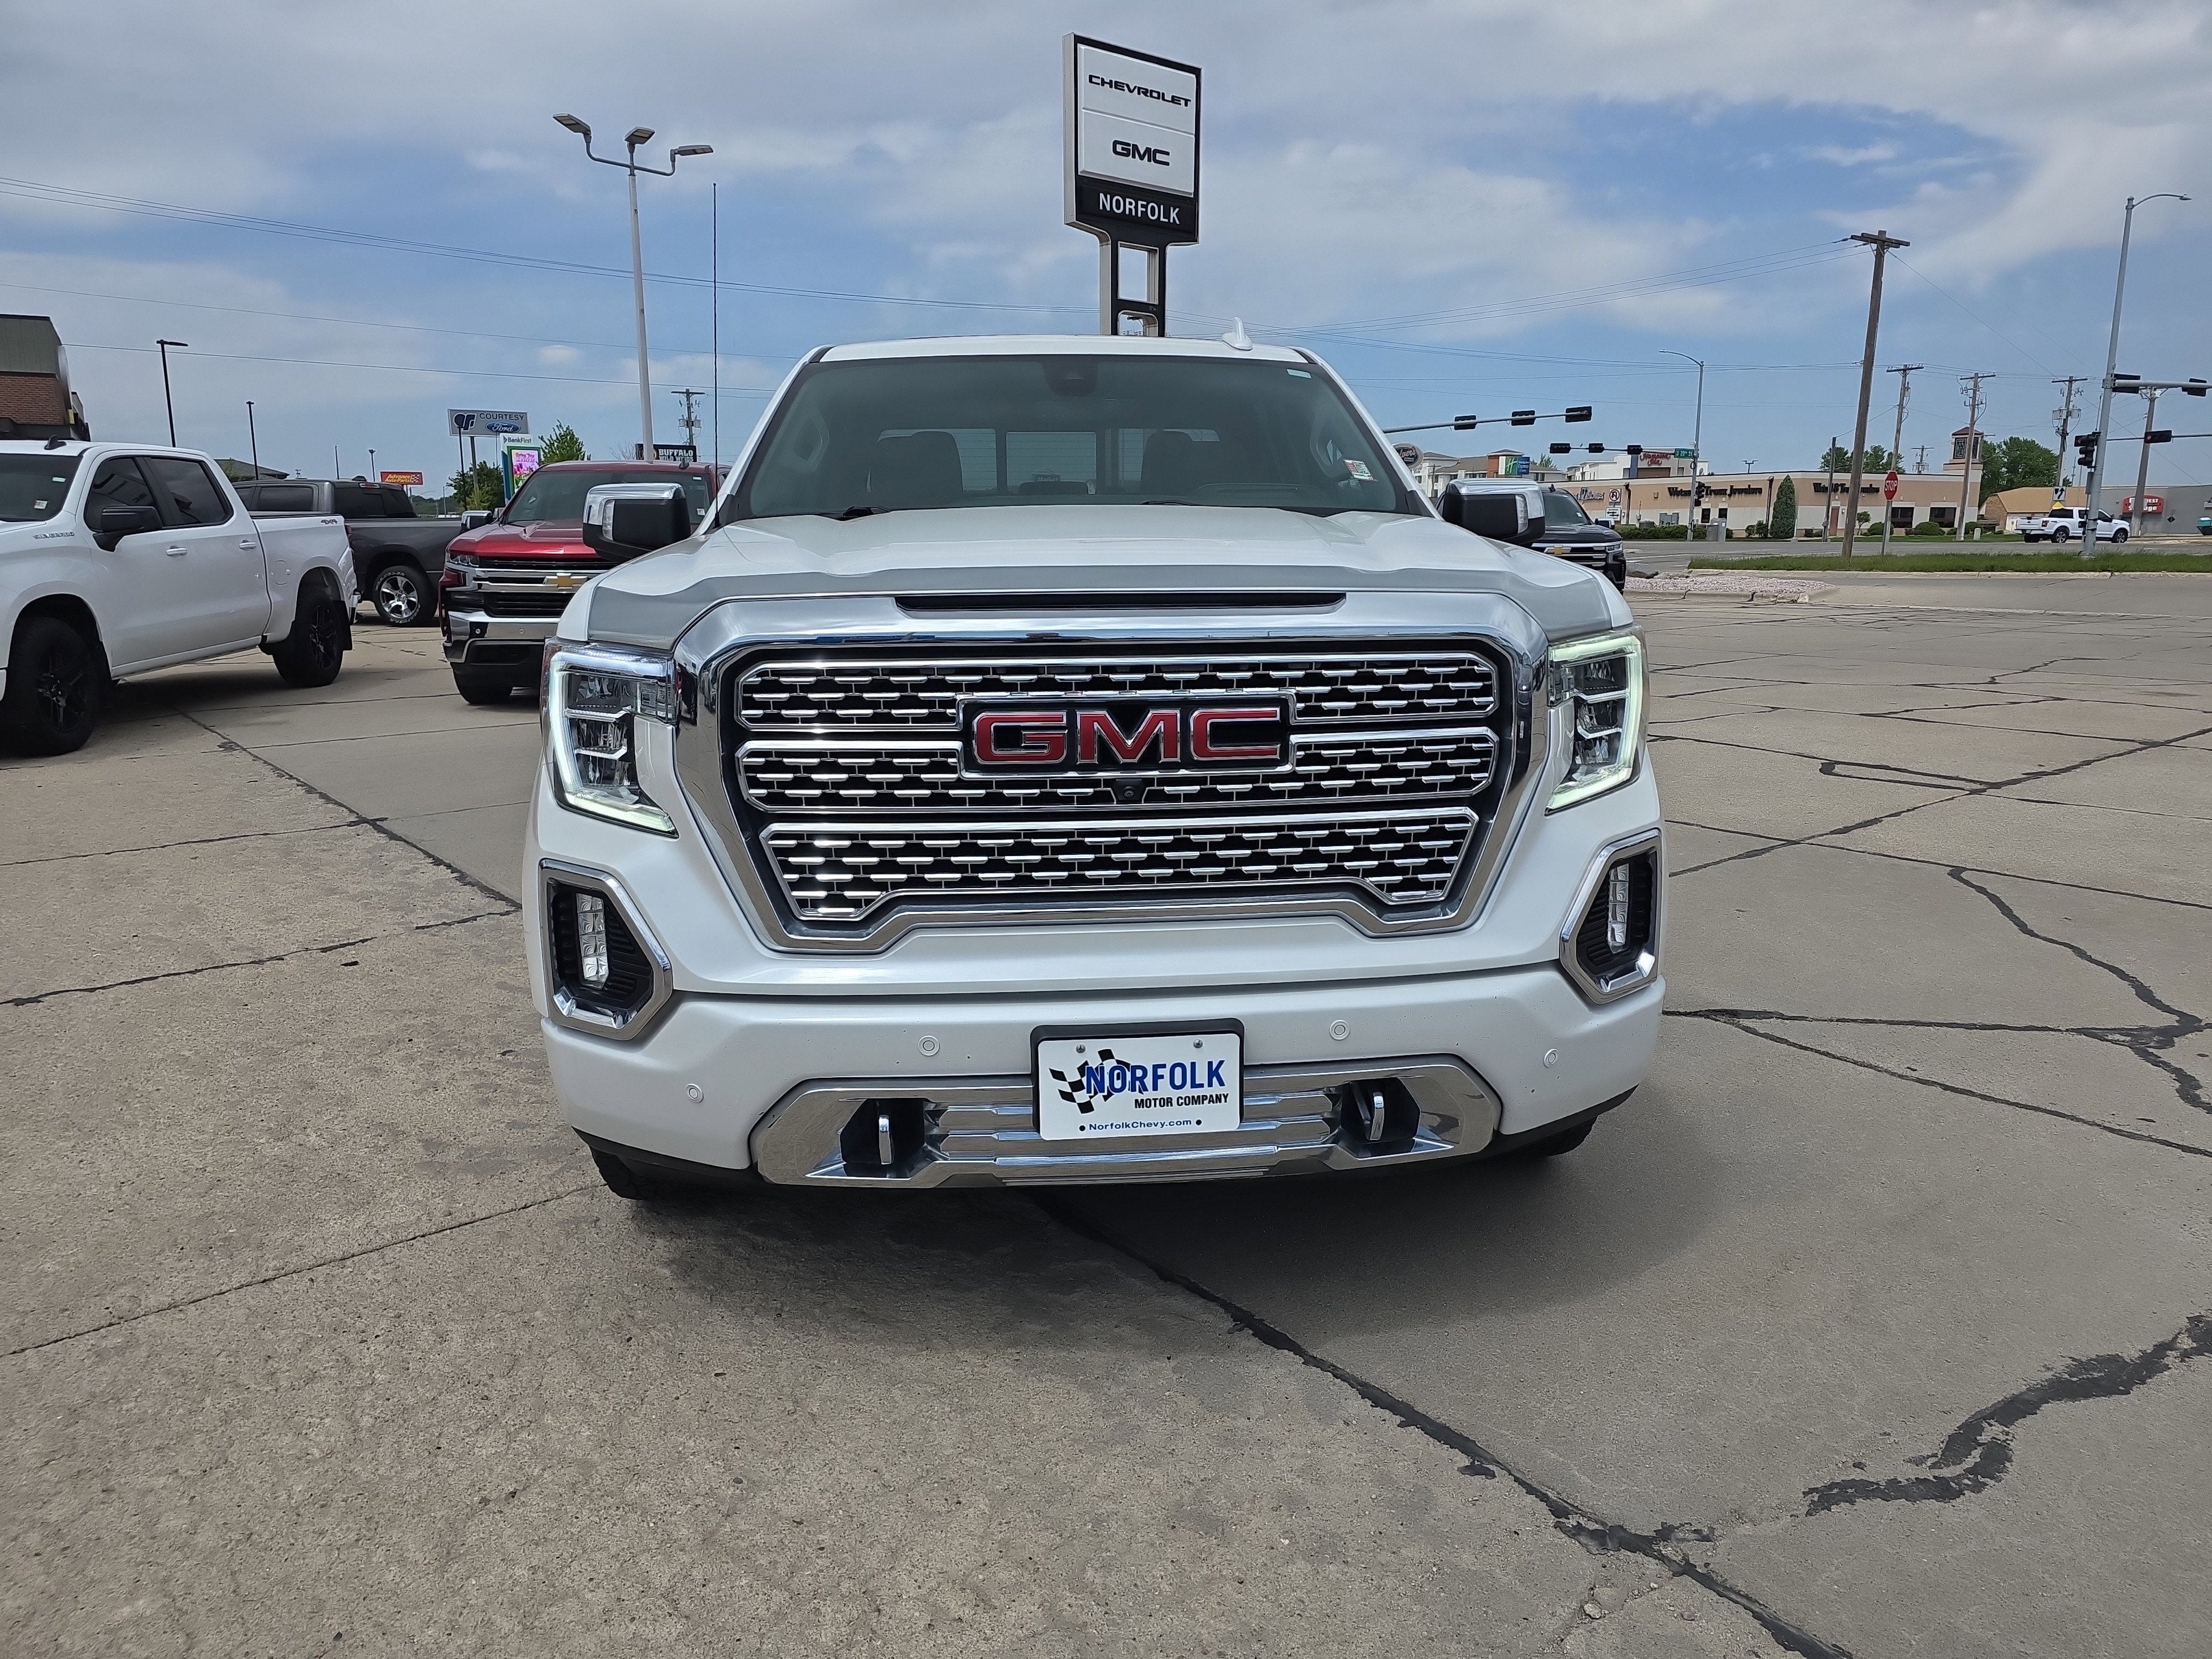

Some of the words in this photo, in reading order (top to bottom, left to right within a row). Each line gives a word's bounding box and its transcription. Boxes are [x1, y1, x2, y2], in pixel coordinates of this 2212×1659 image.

[1088, 74, 1191, 107] CHEVROLET
[1113, 139, 1170, 166] GMC
[1099, 192, 1180, 224] NORFOLK
[479, 413, 524, 421] COURTESY
[492, 423, 514, 432] Ford
[658, 448, 694, 456] BUFFALO
[1727, 484, 1763, 497] Jewelers
[1885, 480, 1898, 491] STOP
[33, 531, 75, 539] SILVERADO
[972, 707, 1282, 764] GMC
[1085, 1059, 1226, 1095] NORFOLK
[1134, 1096, 1174, 1109] MOTOR
[1176, 1093, 1230, 1107] COMPANY
[1089, 1119, 1192, 1131] NorfolkChevy.com
